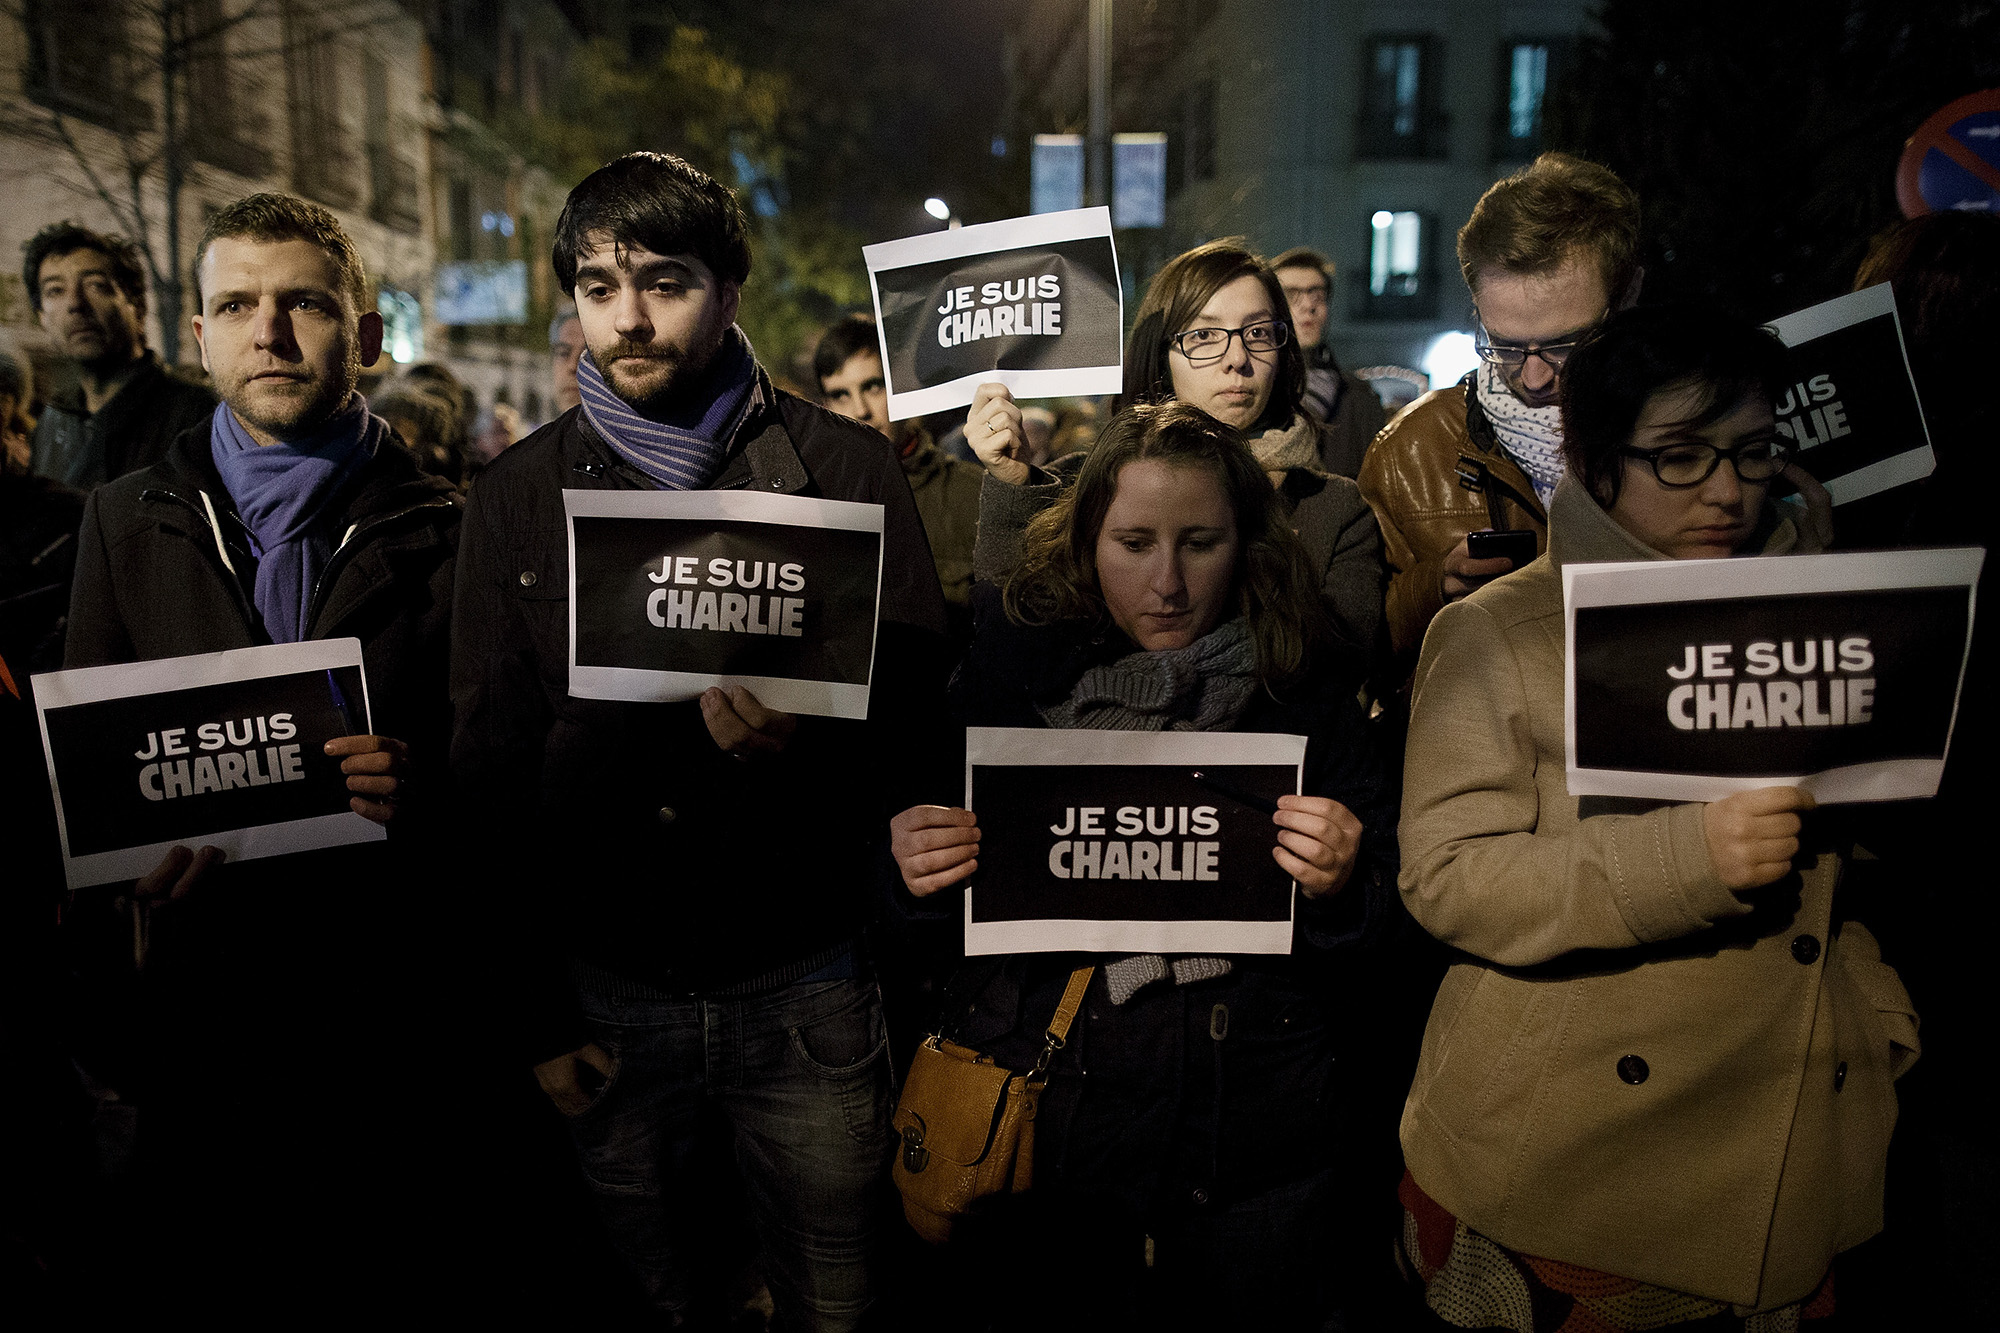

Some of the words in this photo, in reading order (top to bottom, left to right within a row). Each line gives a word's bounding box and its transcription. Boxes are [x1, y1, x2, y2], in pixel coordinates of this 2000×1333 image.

[938, 286, 975, 315] JE
[981, 274, 1061, 309] SUIS
[937, 302, 1062, 348] CHARLIE
[1776, 374, 1837, 416] UIS
[648, 556, 700, 585] JE
[707, 557, 806, 592] SUIS
[646, 588, 806, 638] CHARLIE
[1667, 645, 1735, 680] JE
[1744, 637, 1875, 677] SUIS
[1666, 678, 1876, 731] CHARLIE
[134, 728, 191, 761] JE
[196, 712, 297, 751] SUIS
[138, 743, 306, 801] CHARLIE
[1050, 807, 1106, 836] JE
[1115, 806, 1220, 836] SUIS
[1048, 841, 1220, 881] CHARLIE
